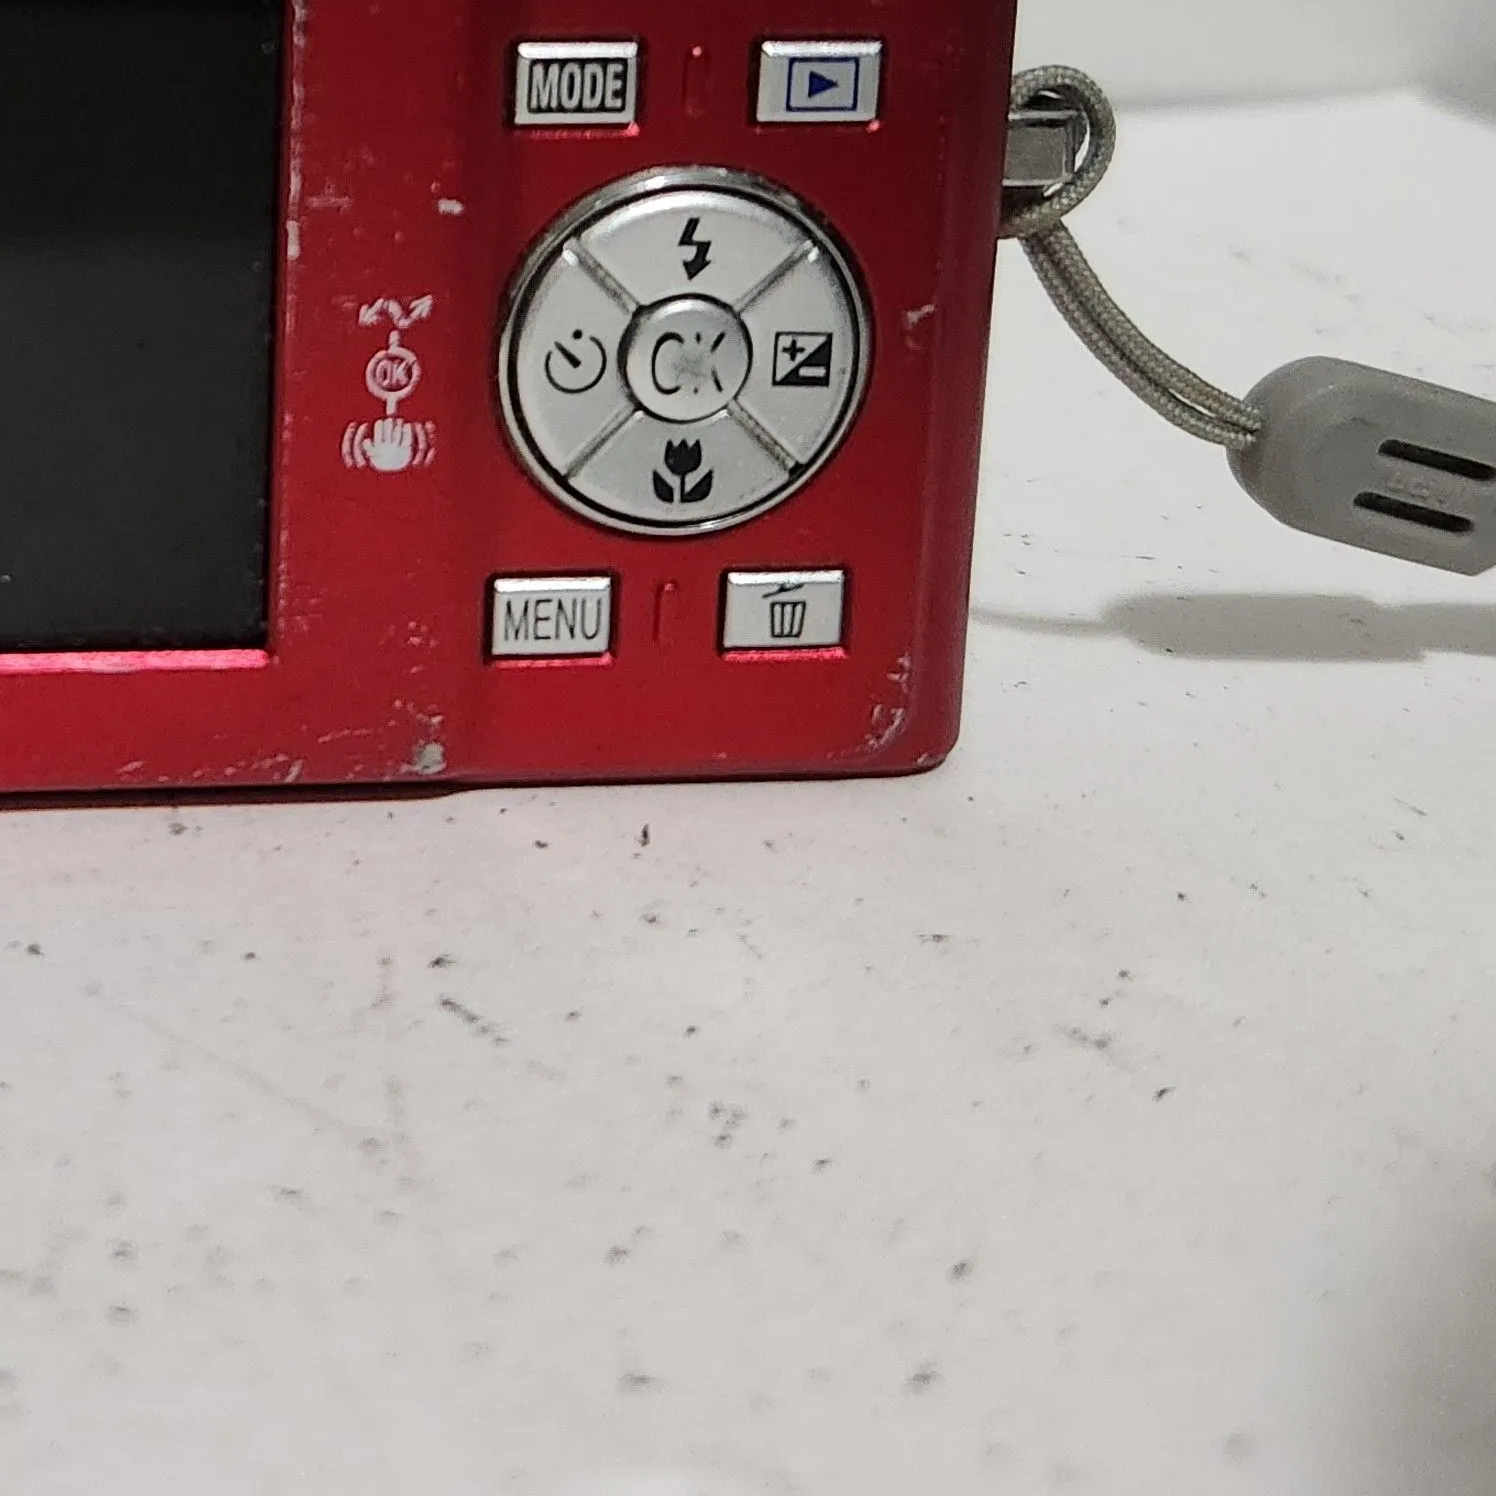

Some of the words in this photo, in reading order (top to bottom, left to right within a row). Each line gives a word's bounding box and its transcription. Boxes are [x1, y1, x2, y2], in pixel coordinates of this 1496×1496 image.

[528, 60, 626, 111] MODE
[376, 359, 409, 387] OK
[504, 599, 603, 642] MENU
